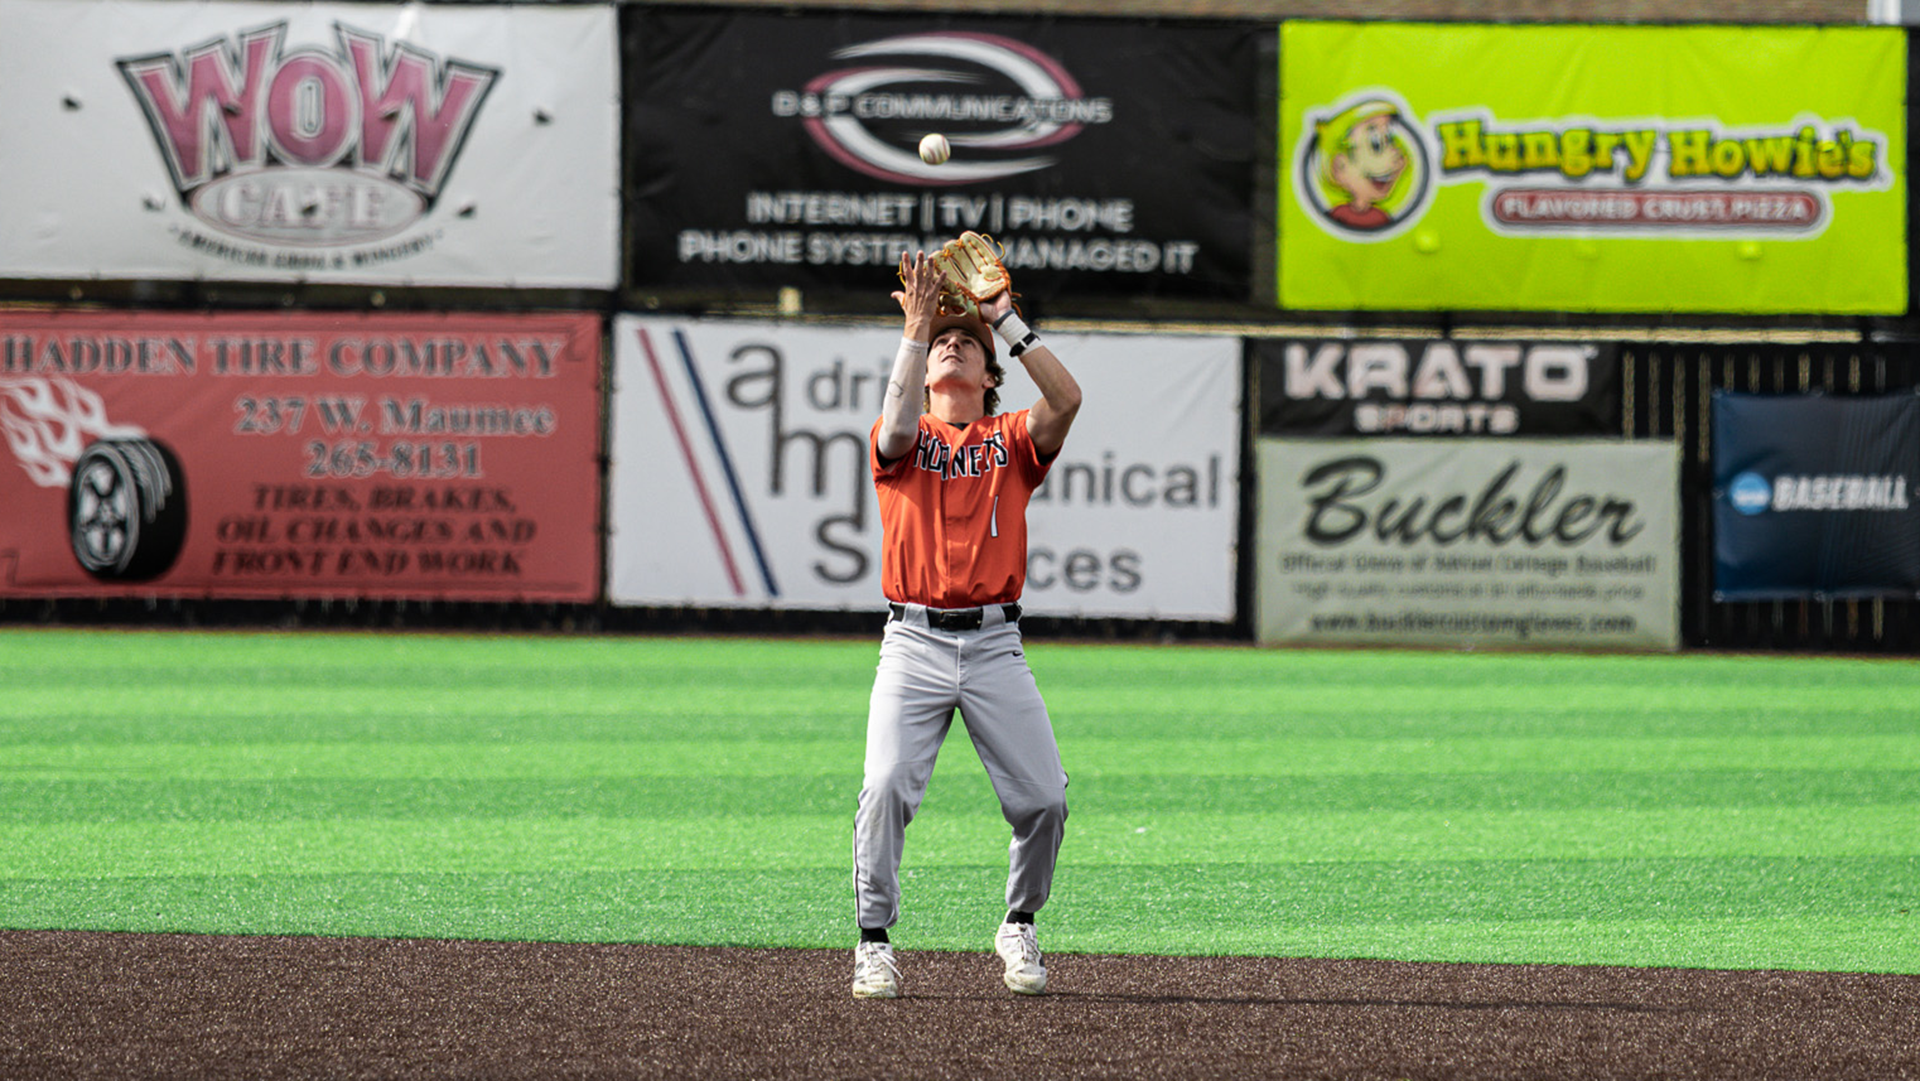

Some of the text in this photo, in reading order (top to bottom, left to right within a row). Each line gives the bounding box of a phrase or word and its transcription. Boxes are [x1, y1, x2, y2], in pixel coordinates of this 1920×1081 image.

[116, 19, 502, 200] WOW
[854, 92, 1113, 124] COMMUNICATIONS
[1437, 119, 1877, 182] Hungry Howie's
[747, 191, 917, 226] INTERNET
[939, 194, 987, 228] TV
[1008, 196, 1135, 233] PHONE
[1503, 198, 1806, 221] FLAVORED CRUST PIZZA
[678, 229, 804, 264] PHONE
[1162, 241, 1199, 274] IT
[2, 335, 566, 379] HADDEN TIRE COMPANY
[1284, 341, 1590, 401] KRATO
[234, 396, 556, 436] 237 W. Maumee
[1354, 403, 1519, 434] SPORTS
[307, 440, 484, 479] 265-8131
[913, 430, 1008, 480] HORNETS
[1300, 455, 1645, 547] Buckler
[1772, 475, 1909, 512] BASEBALL
[215, 516, 537, 545] OIL CHANGES AND
[990, 494, 999, 537] 1
[211, 549, 522, 577] FRONT END WORK
